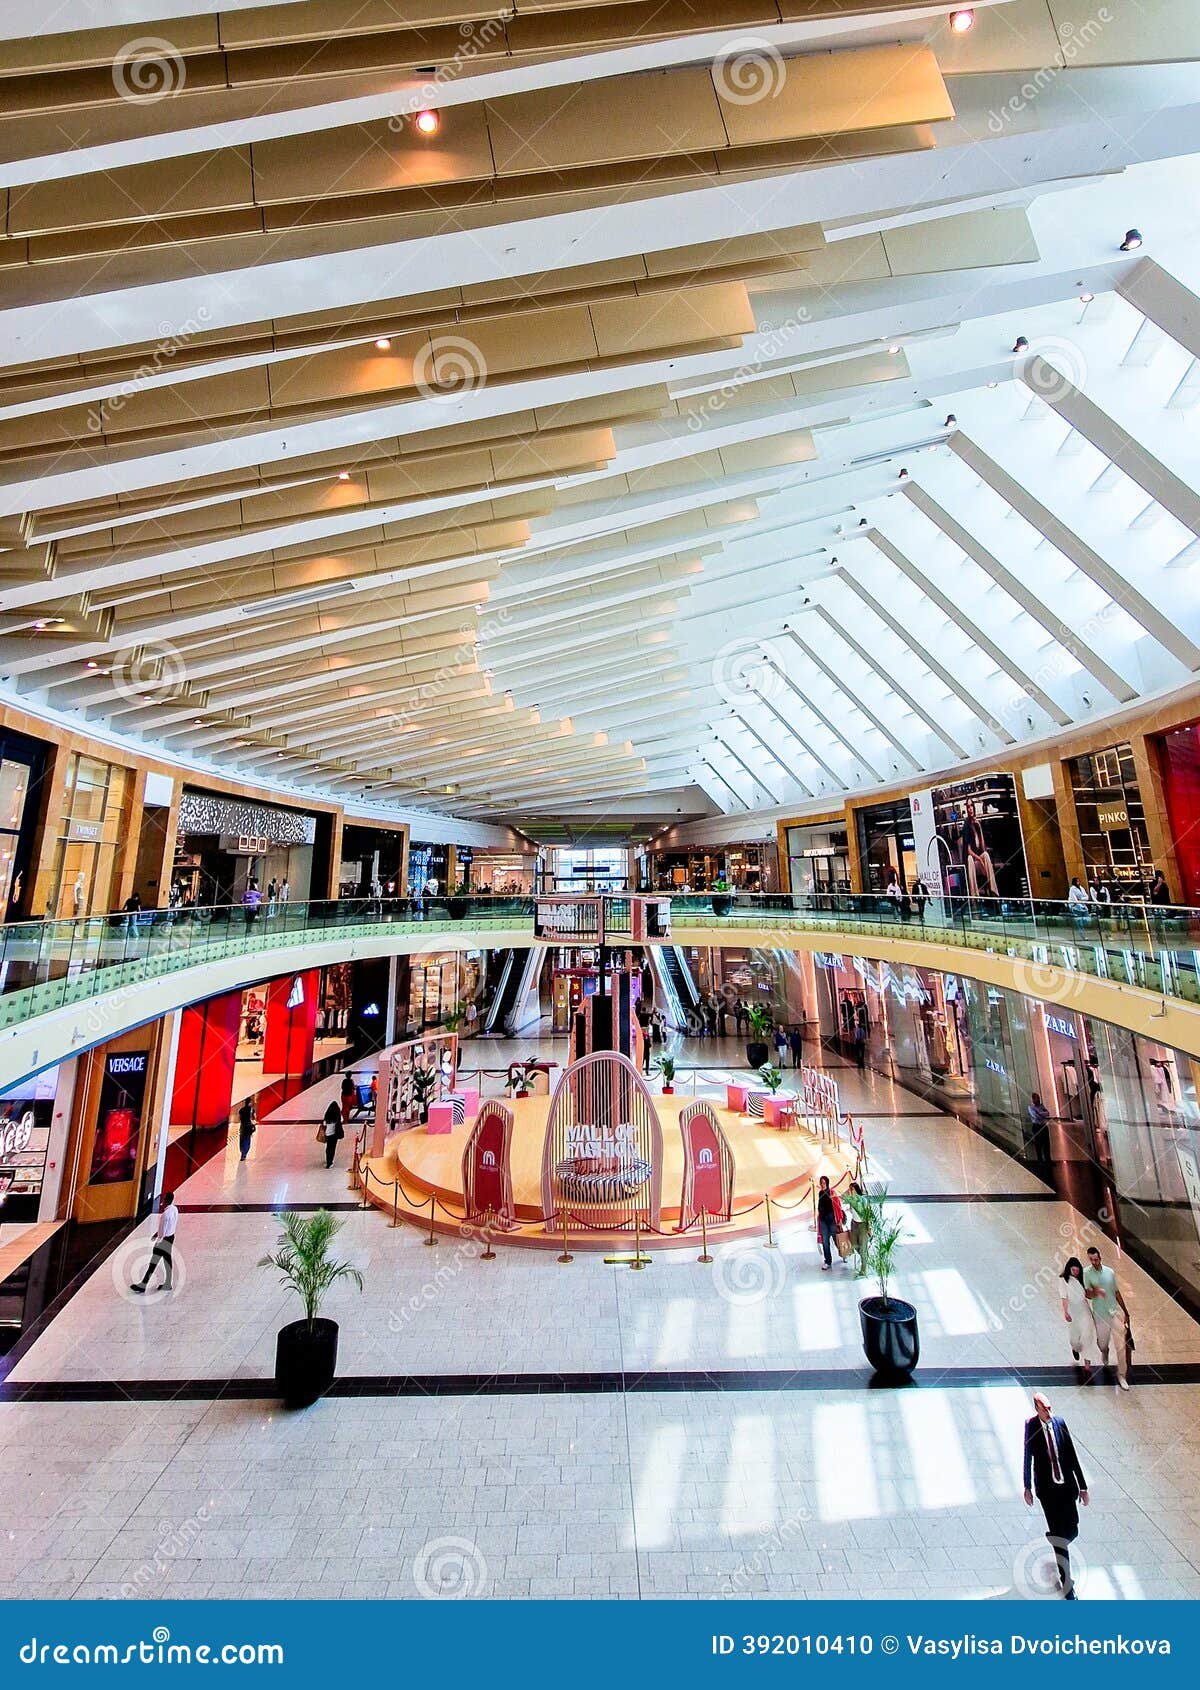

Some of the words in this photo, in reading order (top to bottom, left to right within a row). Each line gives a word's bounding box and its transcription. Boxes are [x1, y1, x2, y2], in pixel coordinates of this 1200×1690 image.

[1099, 811, 1127, 824] PINKO
[1044, 1014, 1077, 1039] ZARA
[109, 1056, 145, 1073] VERSACE
[985, 1059, 1006, 1075] ZARA
[566, 1125, 614, 1141] MALL
[615, 1122, 639, 1141] OF
[566, 1141, 640, 1158] FASHION
